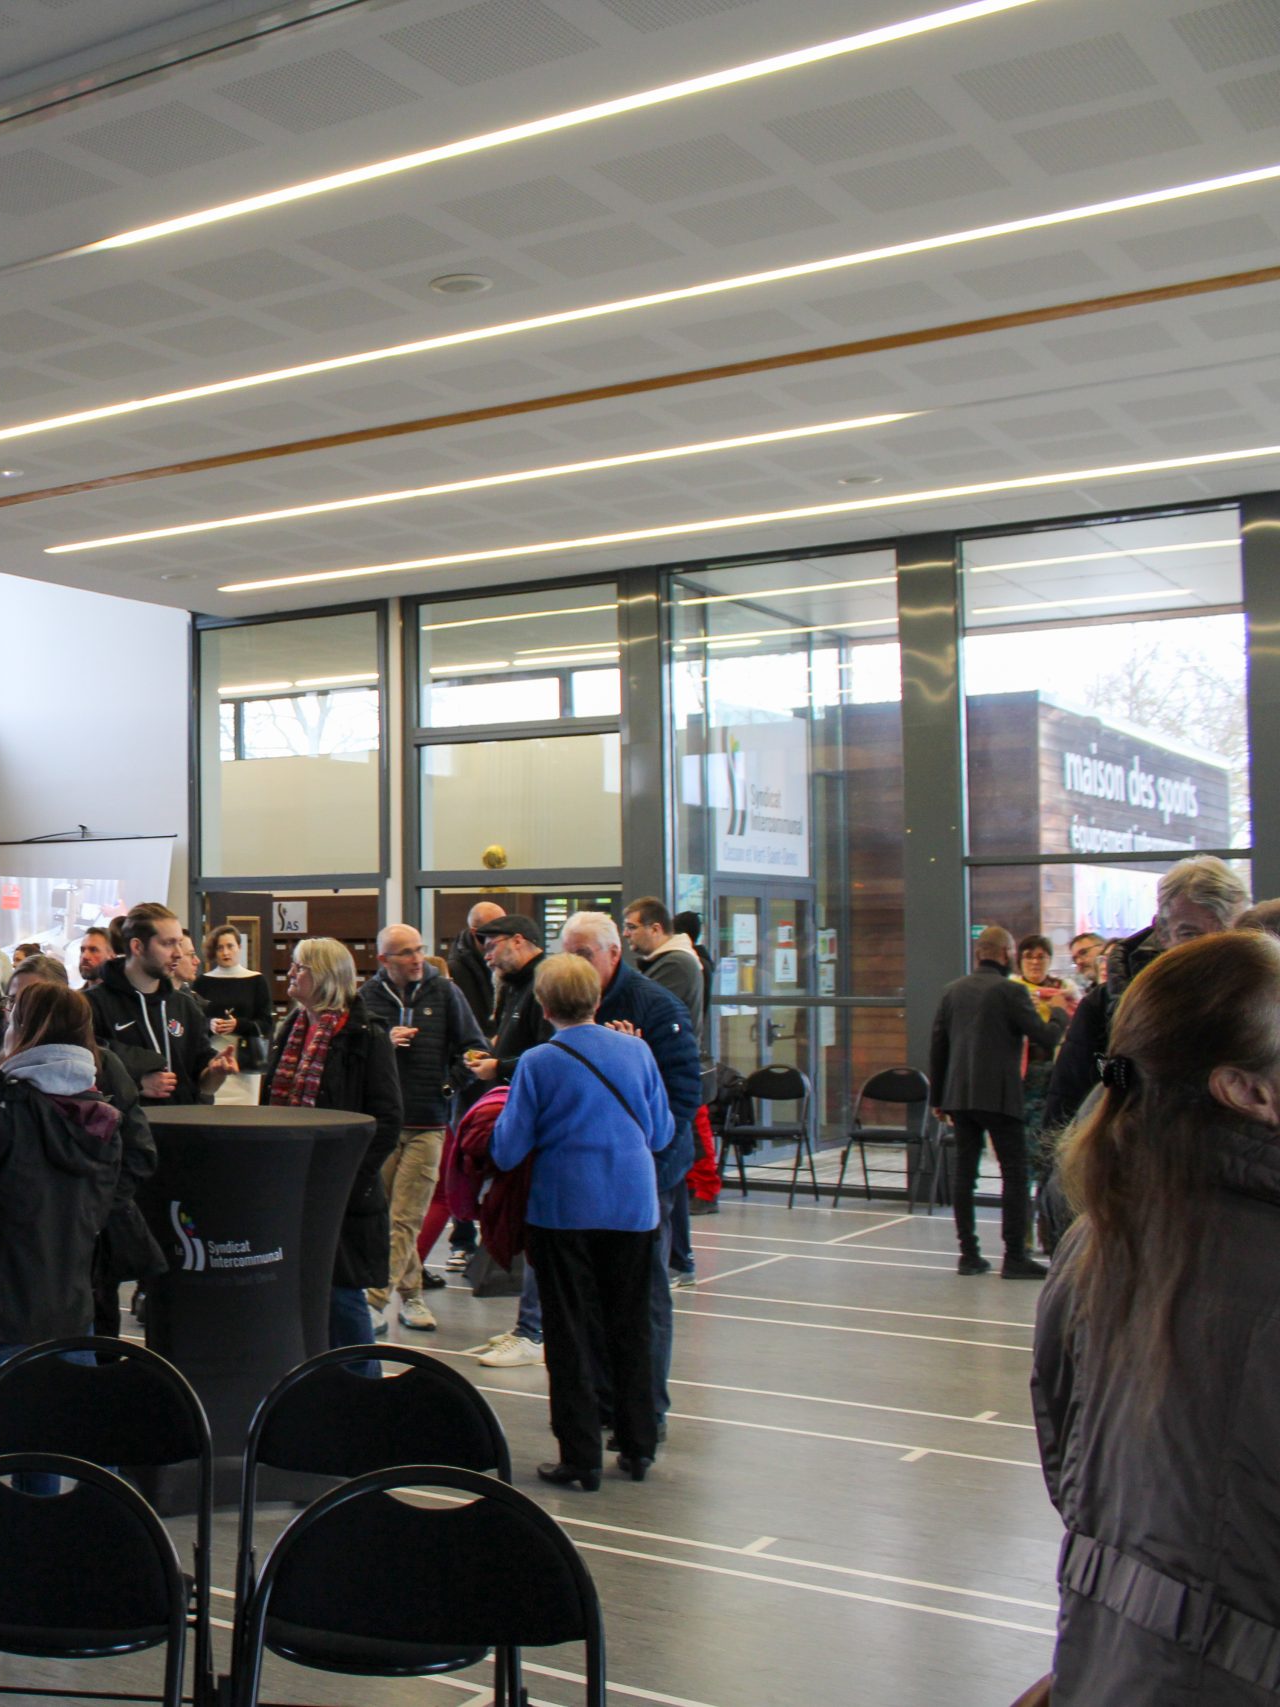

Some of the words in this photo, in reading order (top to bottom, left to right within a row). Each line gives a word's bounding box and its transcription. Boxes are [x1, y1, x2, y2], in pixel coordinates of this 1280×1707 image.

[1064, 742, 1125, 802] maison
[1127, 755, 1156, 809] des
[1157, 776, 1199, 825] sports
[750, 783, 782, 810] Syndicat
[207, 1239, 251, 1256] Syndicat
[209, 1246, 283, 1268] Intercommunal
